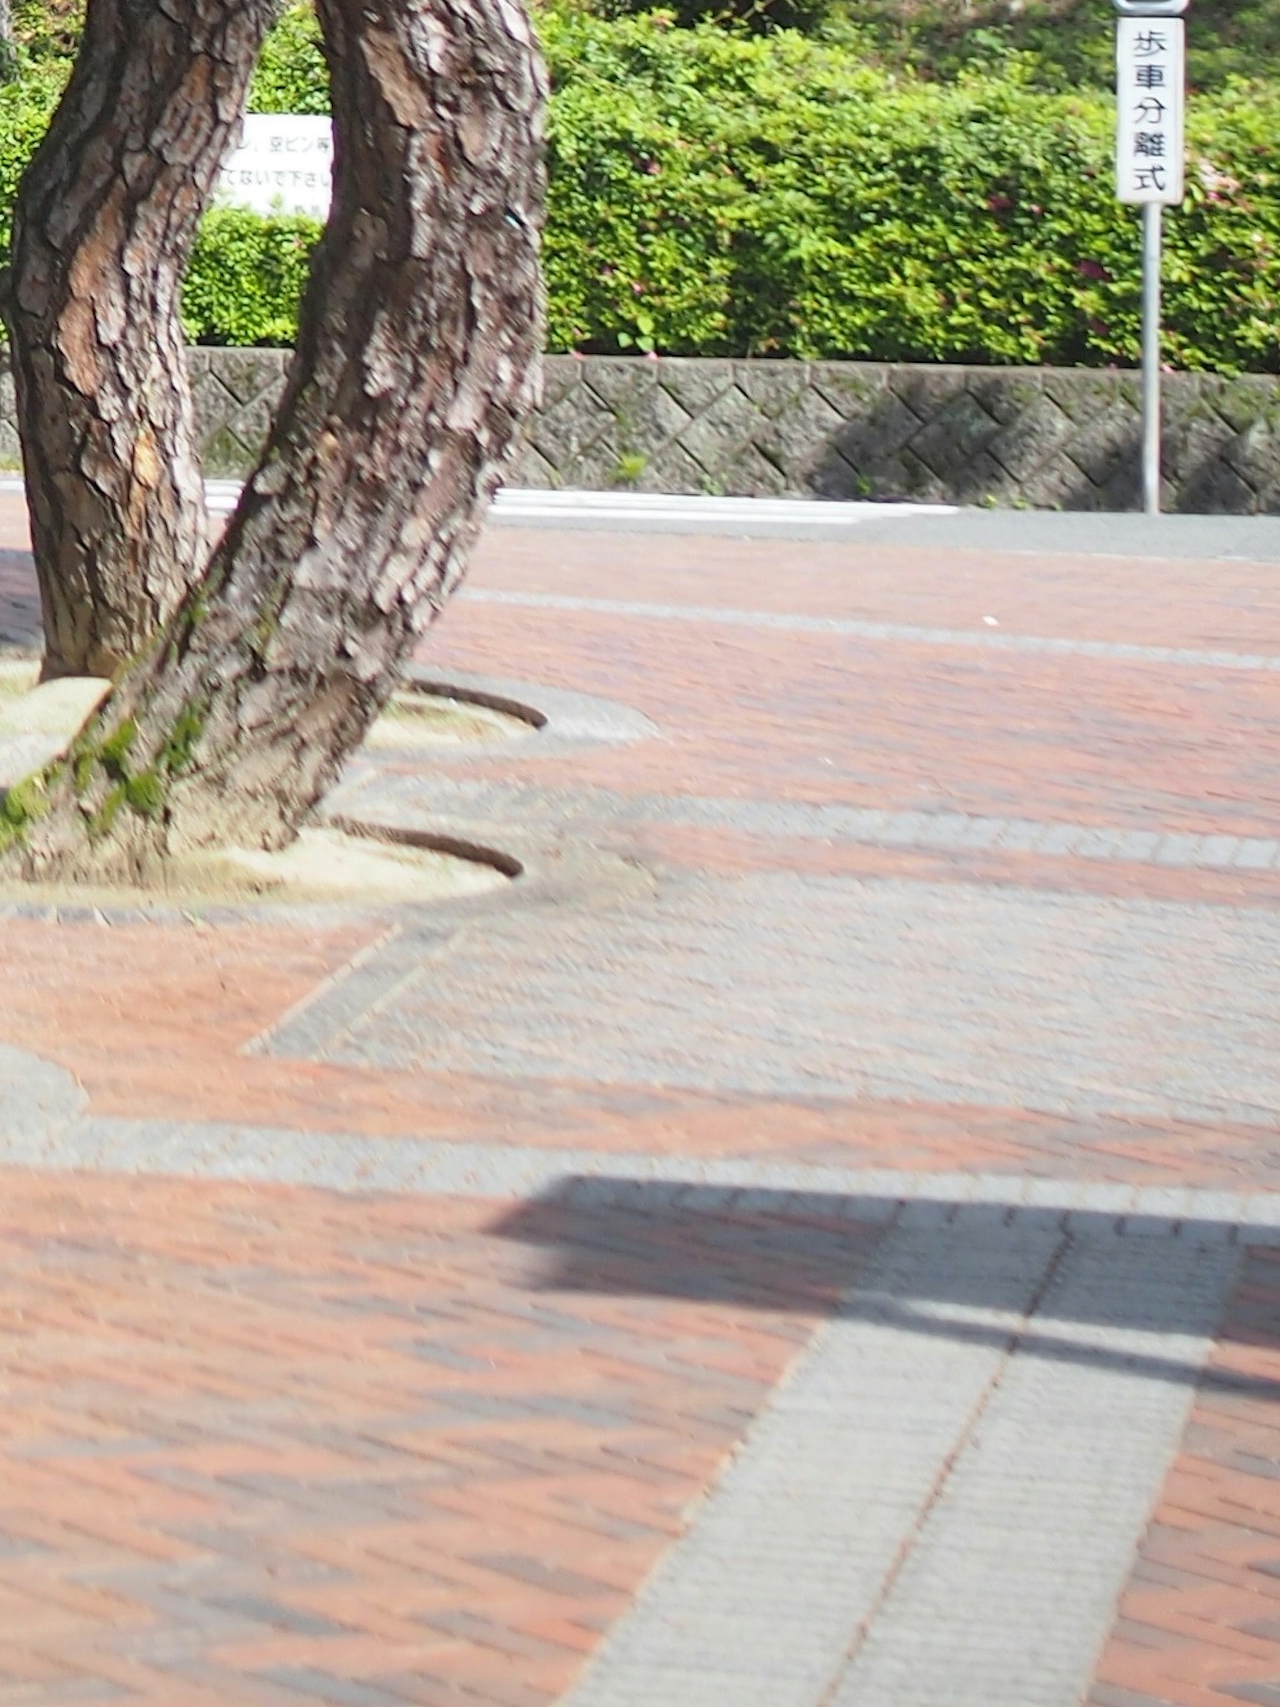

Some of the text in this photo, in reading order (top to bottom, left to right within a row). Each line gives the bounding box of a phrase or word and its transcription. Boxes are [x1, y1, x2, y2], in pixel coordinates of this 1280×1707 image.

[1133, 30, 1168, 192] 歩車分離式
